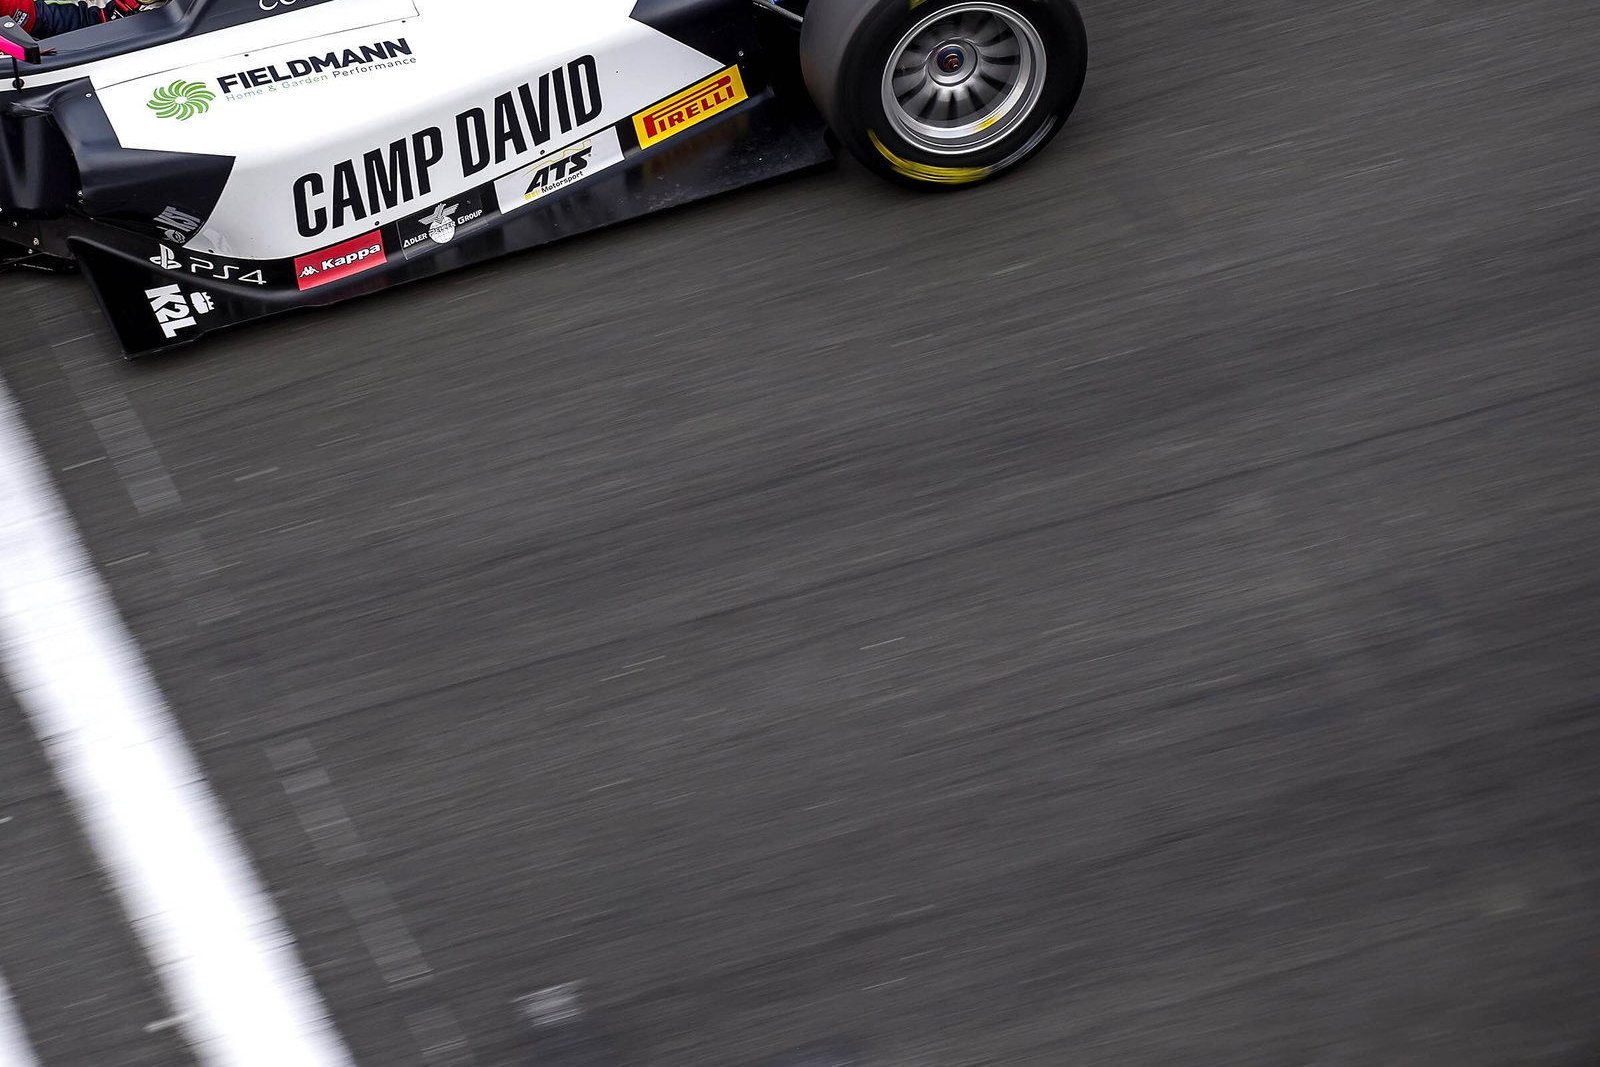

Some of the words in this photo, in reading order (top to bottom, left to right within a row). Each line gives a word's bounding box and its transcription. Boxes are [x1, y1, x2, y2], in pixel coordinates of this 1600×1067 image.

[216, 37, 413, 94] FIELDMANN
[226, 88, 263, 102] Home
[281, 73, 329, 90] Garden
[332, 55, 417, 79] Performance
[643, 75, 735, 139] PIRELLI
[292, 126, 444, 238] CAMP
[455, 54, 603, 178] DAVID
[524, 145, 593, 194] ATS
[541, 170, 584, 194] Motorsport
[403, 232, 428, 248] ADLER
[457, 209, 483, 225] GROUP
[189, 256, 267, 285] PS4
[321, 243, 381, 270] Kappa
[144, 283, 197, 339] K2L
